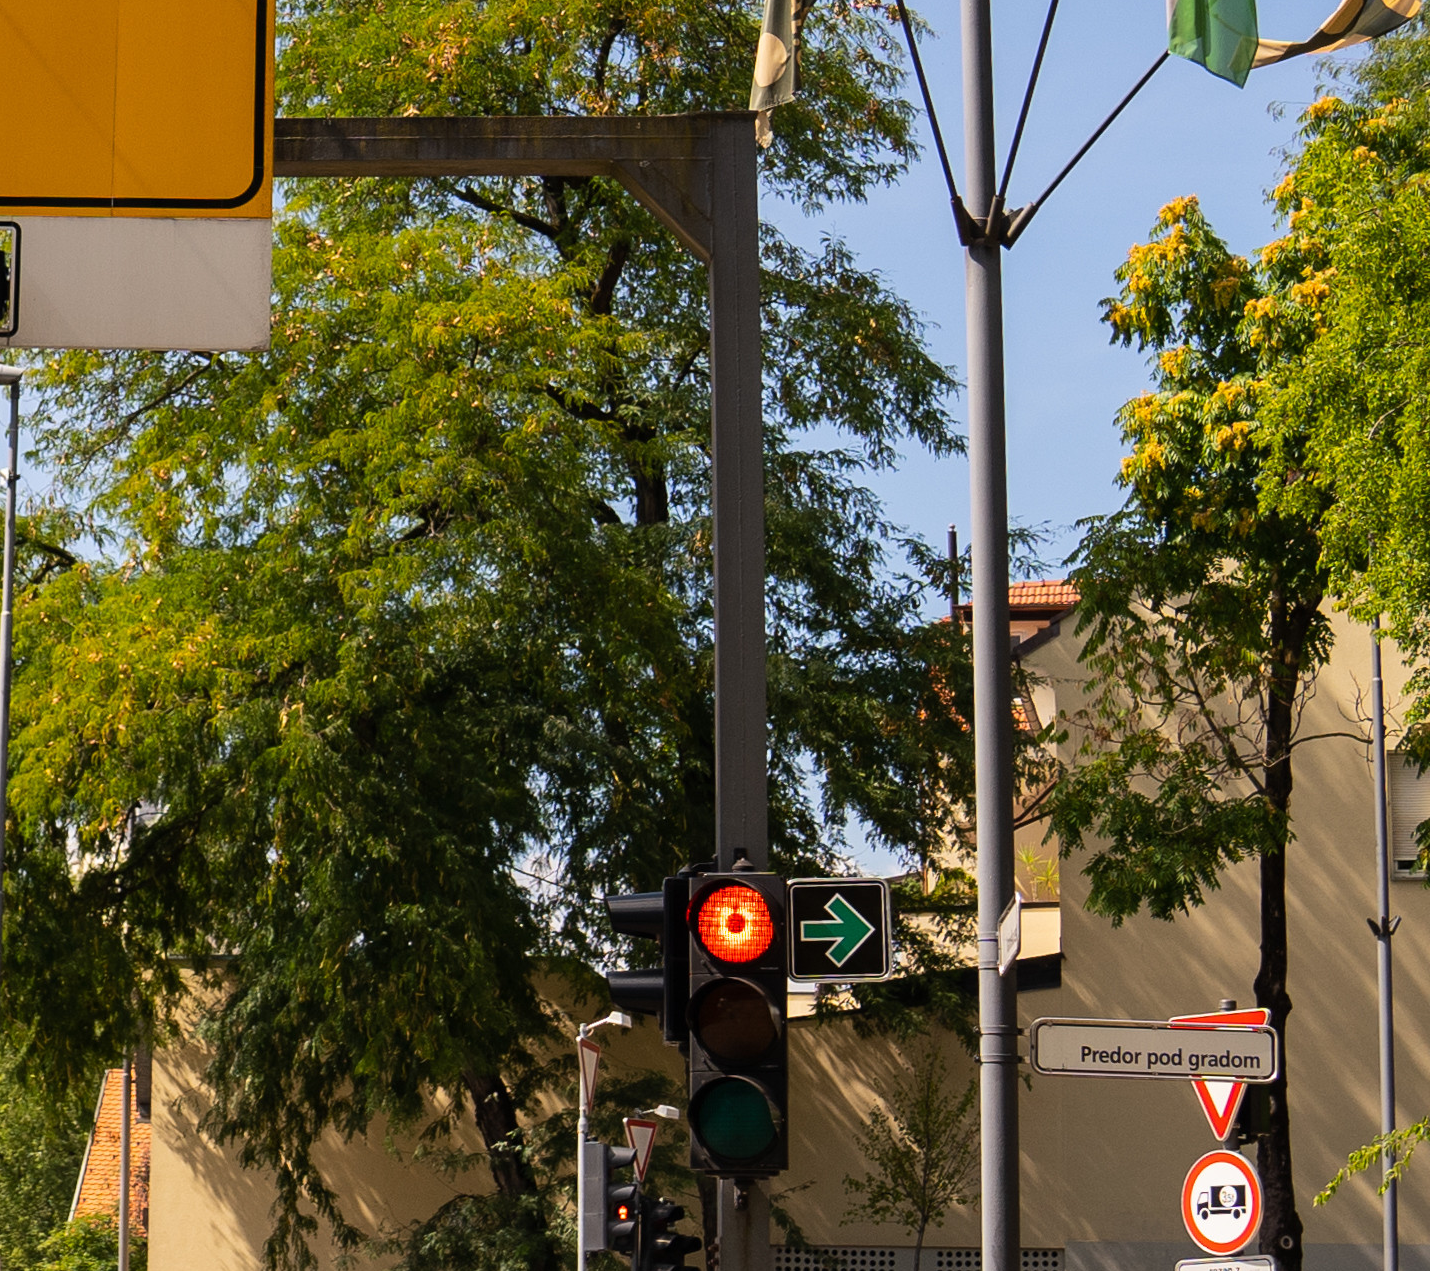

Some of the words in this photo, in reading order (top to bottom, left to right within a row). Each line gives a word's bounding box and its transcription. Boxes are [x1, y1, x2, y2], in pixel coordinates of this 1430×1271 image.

[1081, 1046, 1142, 1065] Predor
[1147, 1048, 1182, 1068] pod
[1188, 1050, 1260, 1071] gradom
